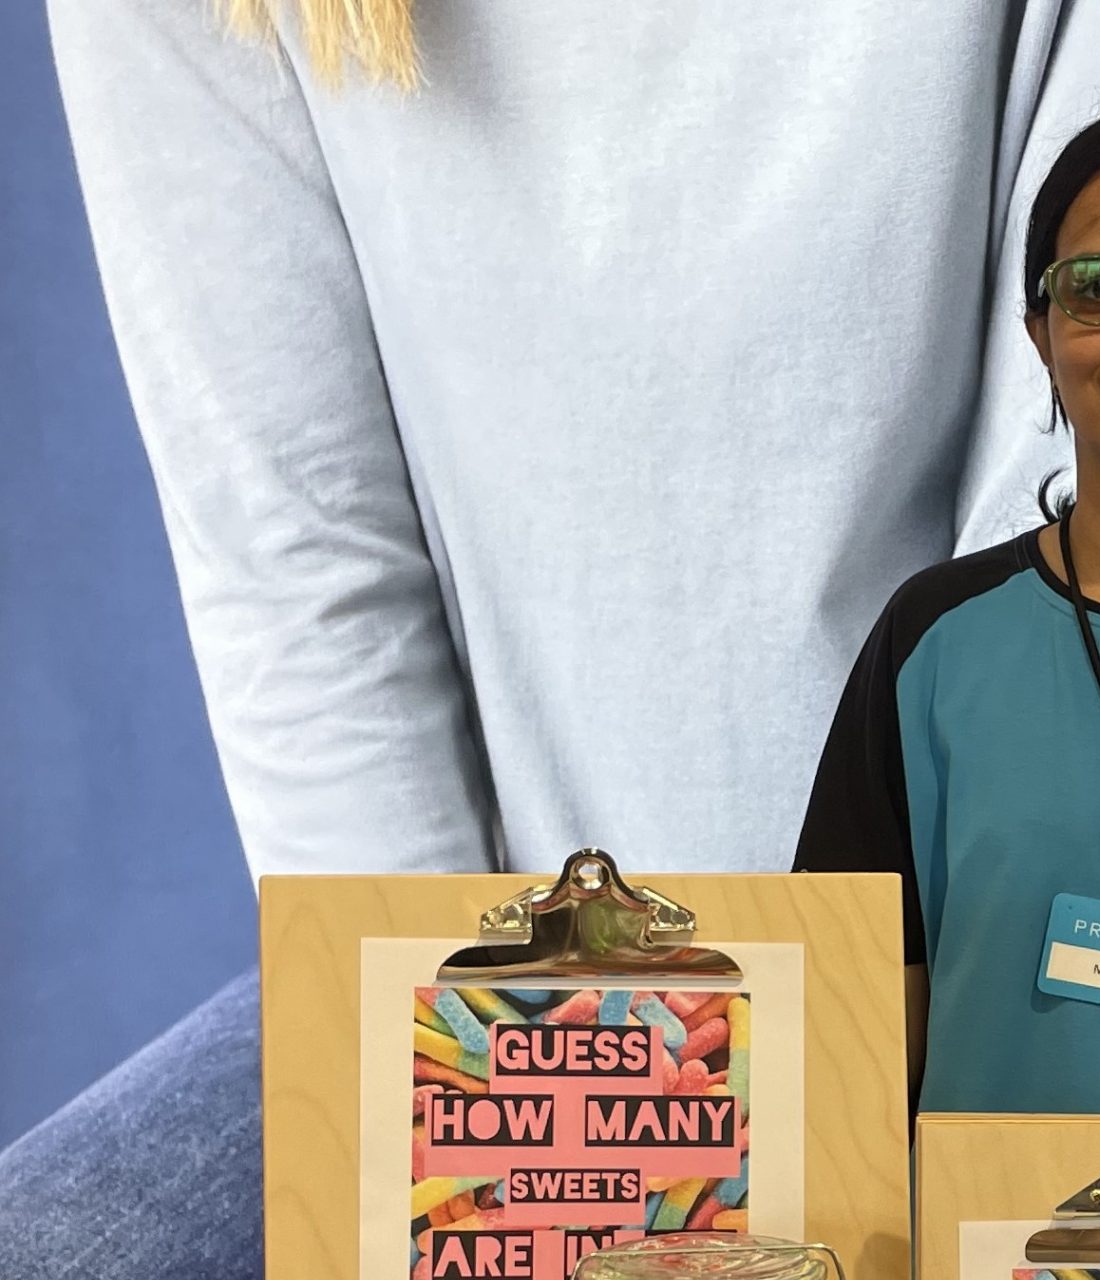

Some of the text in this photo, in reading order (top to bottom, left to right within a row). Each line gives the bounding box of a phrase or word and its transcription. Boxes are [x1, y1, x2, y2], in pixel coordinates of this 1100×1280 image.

[496, 1028, 650, 1073] GUESS
[432, 1097, 734, 1144] HOW MANY
[511, 1171, 640, 1201] SWEETS
[433, 1234, 533, 1279] ARE
